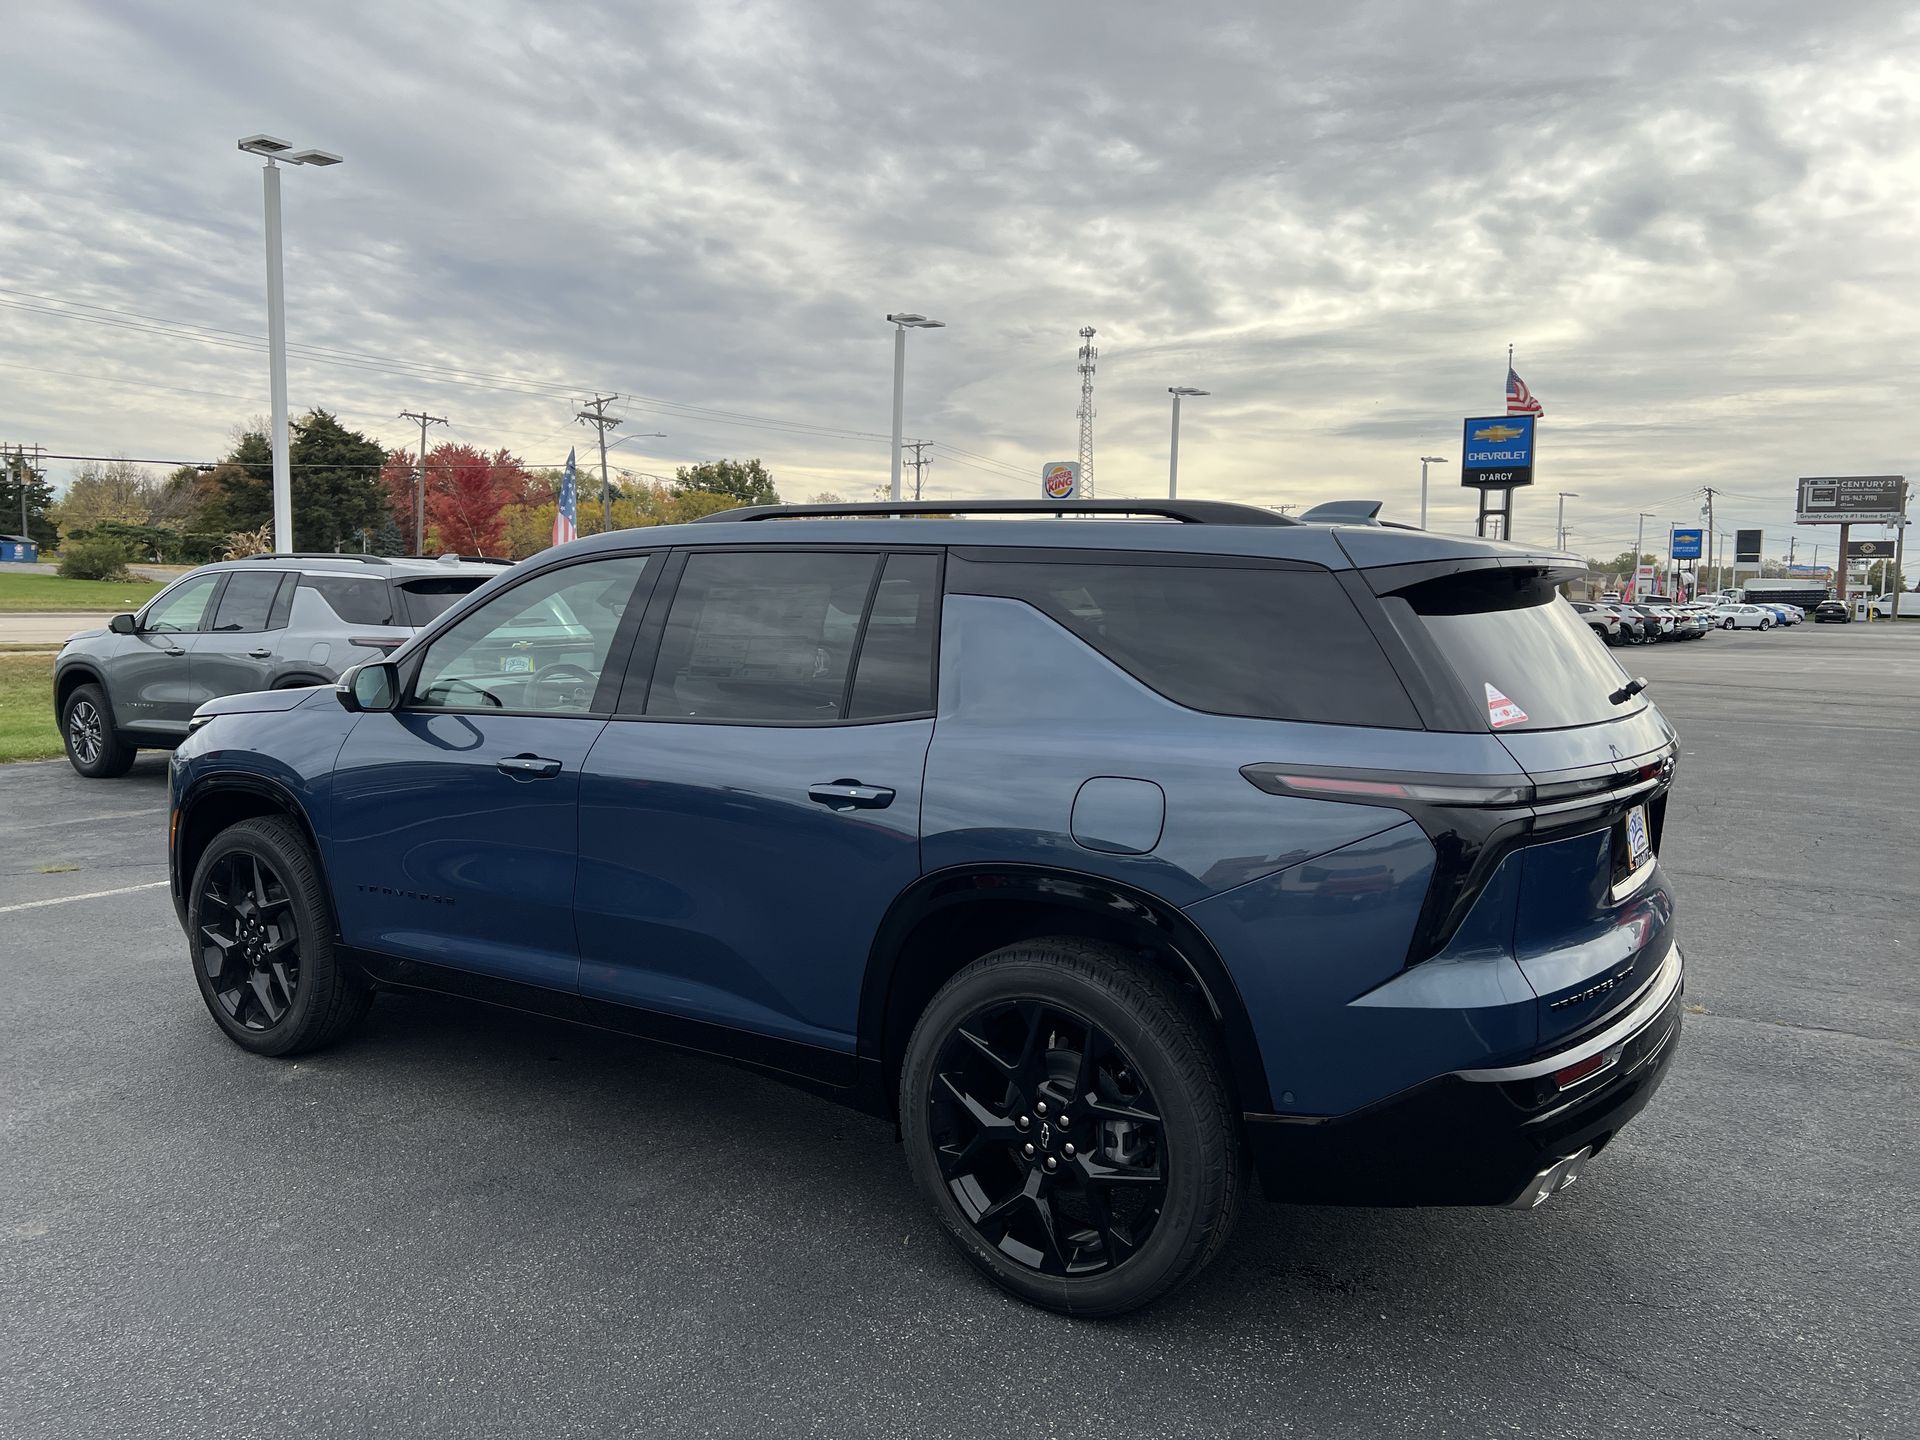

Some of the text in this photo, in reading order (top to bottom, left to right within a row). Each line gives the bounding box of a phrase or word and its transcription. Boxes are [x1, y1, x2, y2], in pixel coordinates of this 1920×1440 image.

[1468, 451, 1526, 460] CHEVROLET
[1048, 477, 1073, 492] KING
[357, 884, 456, 904] TRAVERSE
[1550, 978, 1613, 1012] TRAVERSE
